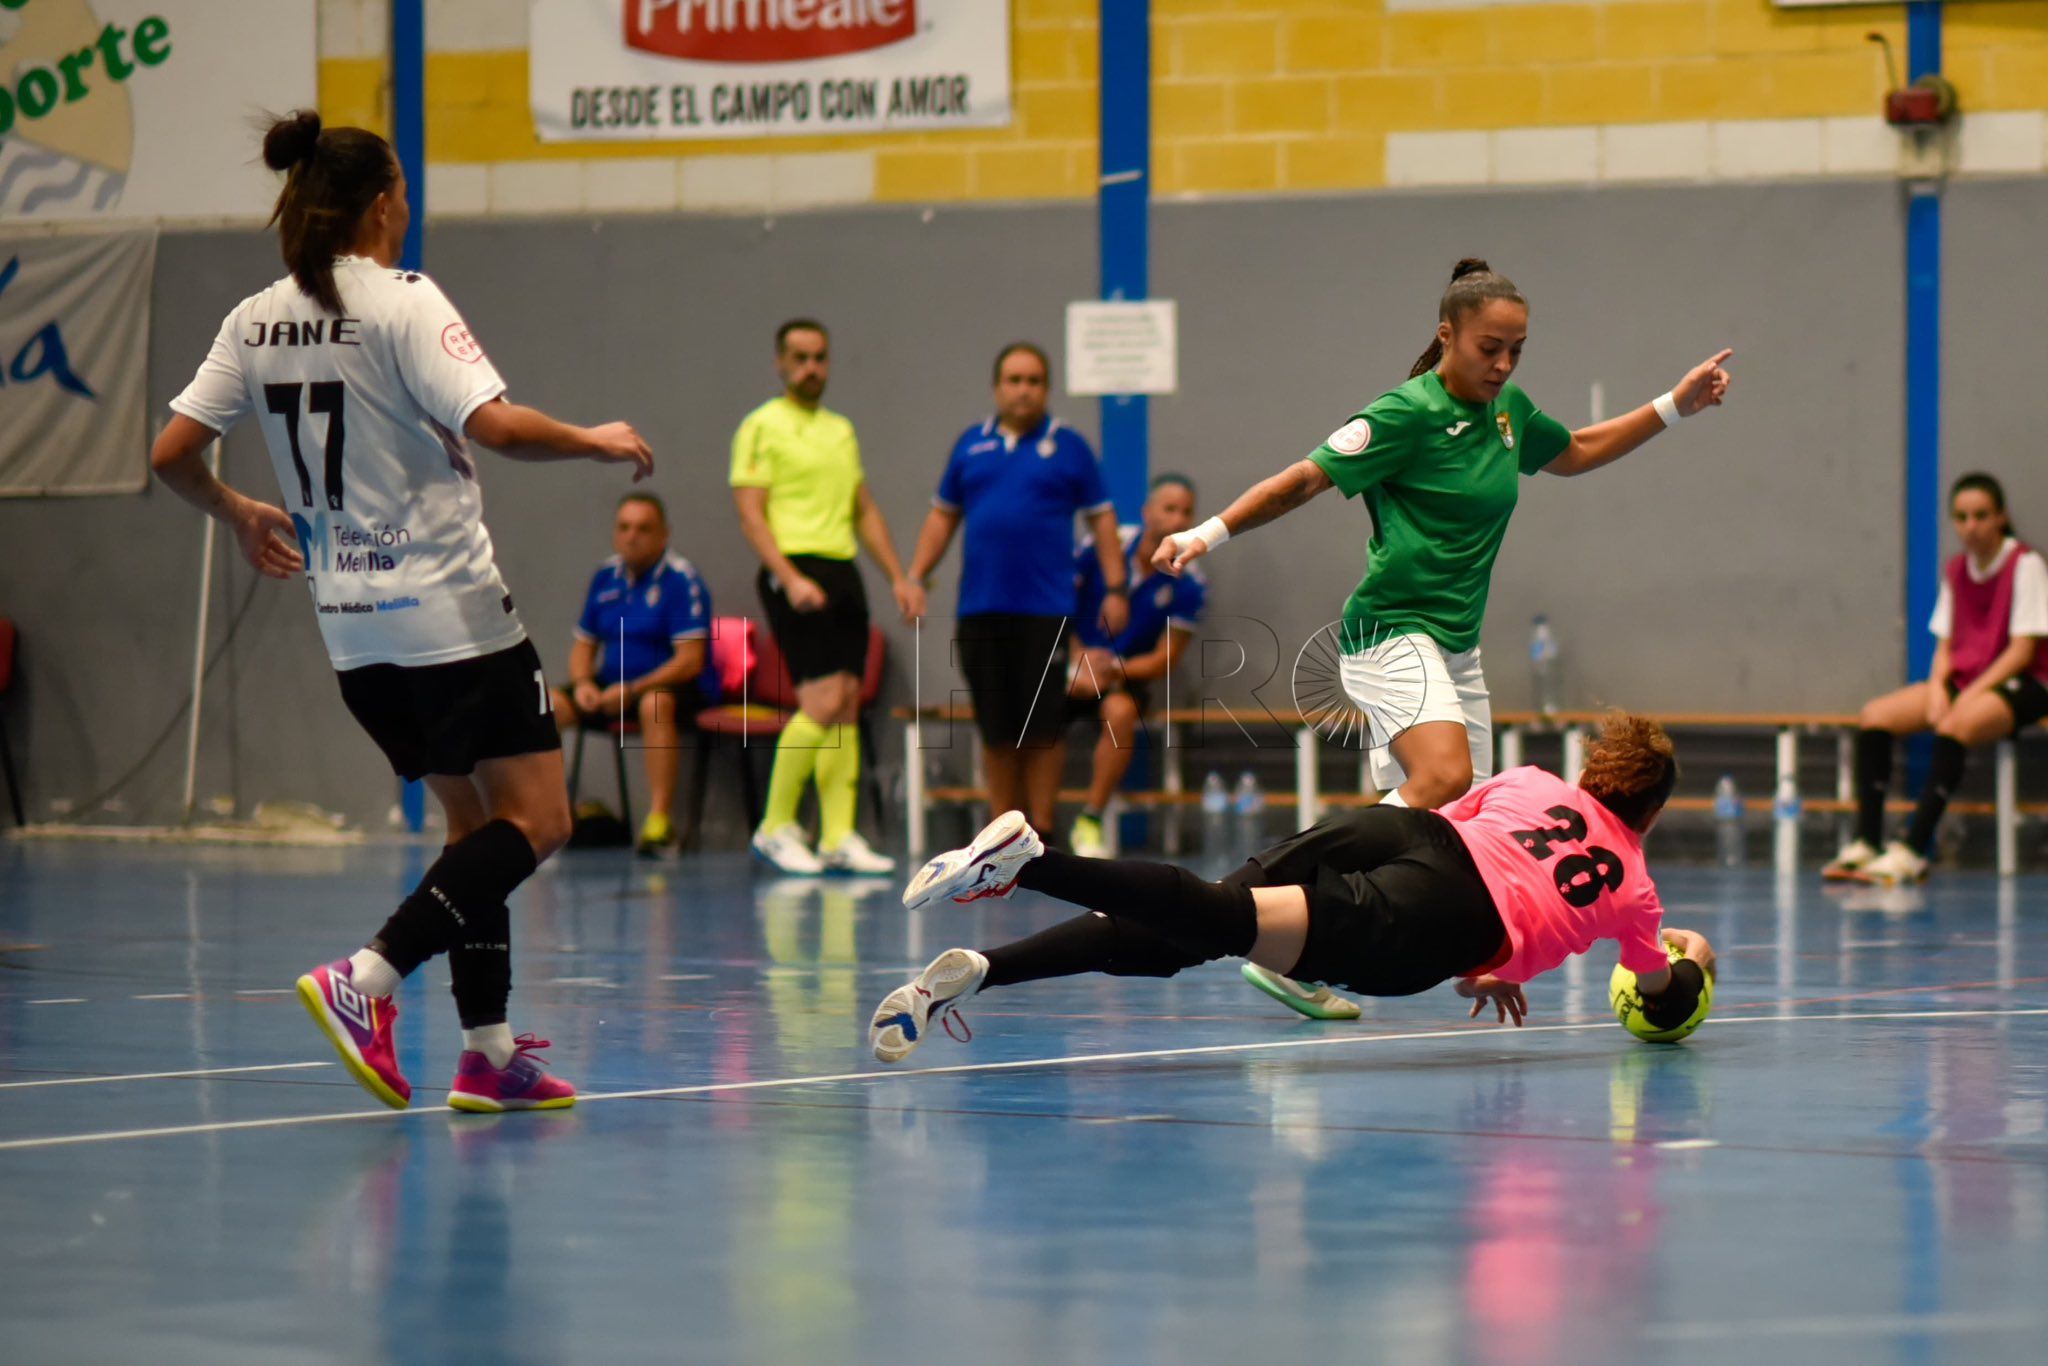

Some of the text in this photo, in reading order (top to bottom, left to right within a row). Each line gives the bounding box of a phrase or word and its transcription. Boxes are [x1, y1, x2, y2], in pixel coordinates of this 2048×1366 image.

[571, 73, 970, 128] DESDE EL CAMPO CON AMOR
[245, 318, 361, 347] JANE
[333, 525, 411, 547] Teleión
[1510, 805, 1624, 908] 28
